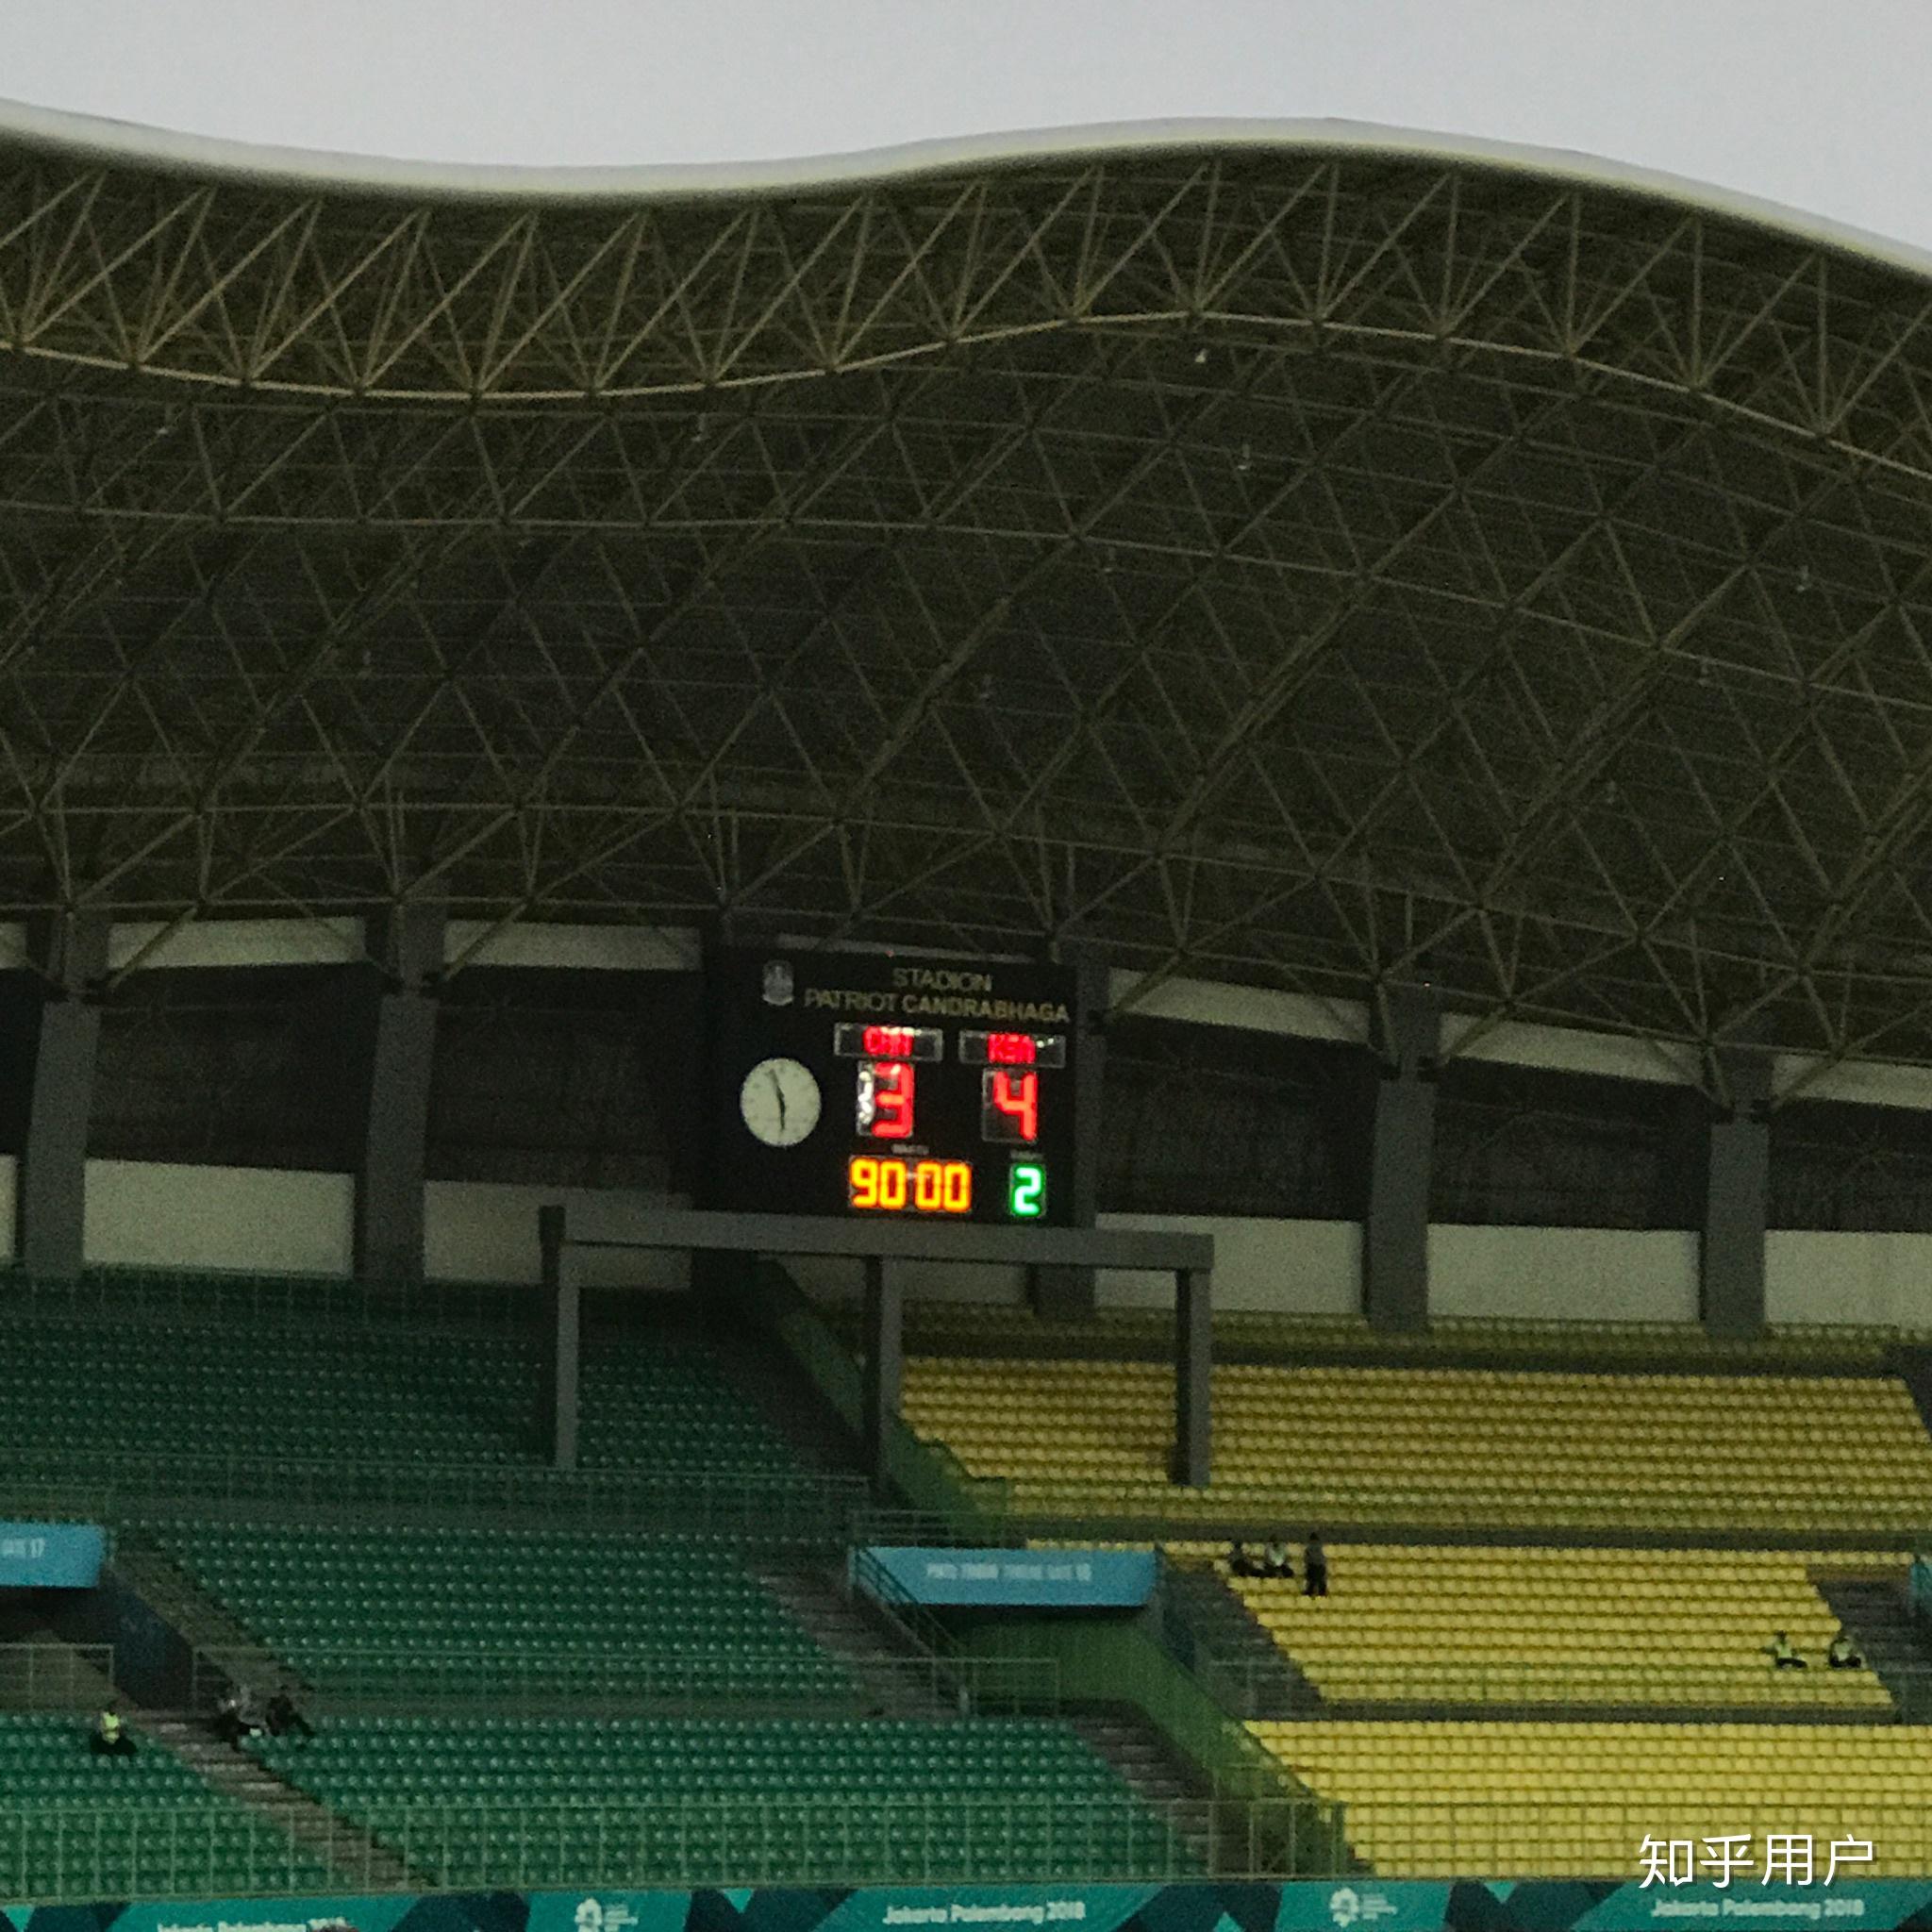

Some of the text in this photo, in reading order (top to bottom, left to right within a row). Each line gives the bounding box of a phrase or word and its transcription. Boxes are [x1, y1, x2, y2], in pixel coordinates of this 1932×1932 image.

[893, 967, 992, 992] STADION
[804, 988, 1071, 1023] PATRIOT CANDRABHAGA
[873, 1061, 915, 1139] 3
[993, 1070, 1037, 1141] 4
[1011, 1163, 1045, 1217] 2
[882, 1905, 947, 1924] Jakarta
[951, 1903, 1044, 1925] Palembang
[1651, 1898, 1720, 1918] Jakarta
[1723, 1898, 1822, 1921] Palembang
